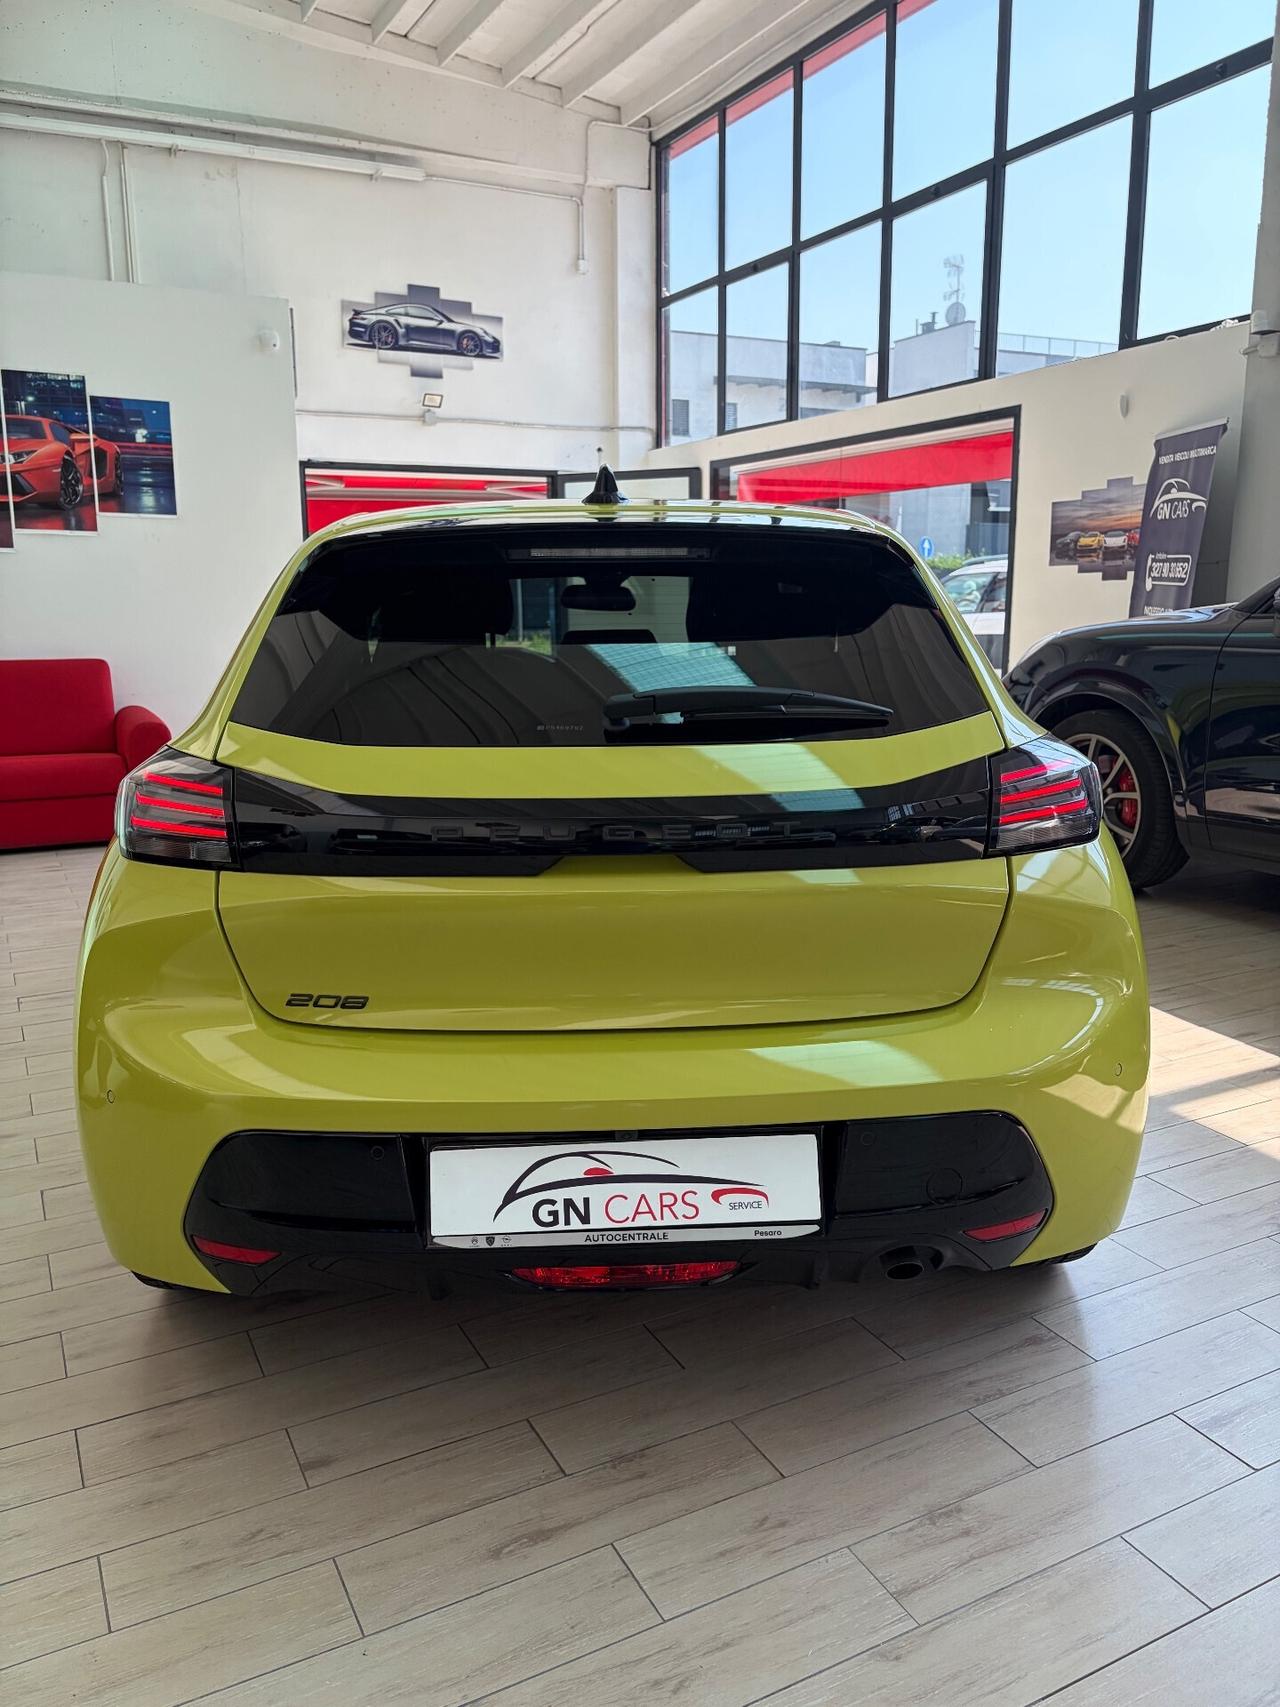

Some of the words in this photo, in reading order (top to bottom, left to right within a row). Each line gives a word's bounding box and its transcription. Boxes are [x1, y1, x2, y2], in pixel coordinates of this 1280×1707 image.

[1157, 502, 1171, 520] GN
[1171, 499, 1191, 519] CARS
[431, 821, 802, 842] PEUGEOT
[285, 993, 369, 1009] 208
[532, 1196, 591, 1228] GN
[604, 1190, 700, 1224] CARS
[728, 1200, 763, 1211] SERVICE
[584, 1231, 669, 1242] AUTOCENTRALE
